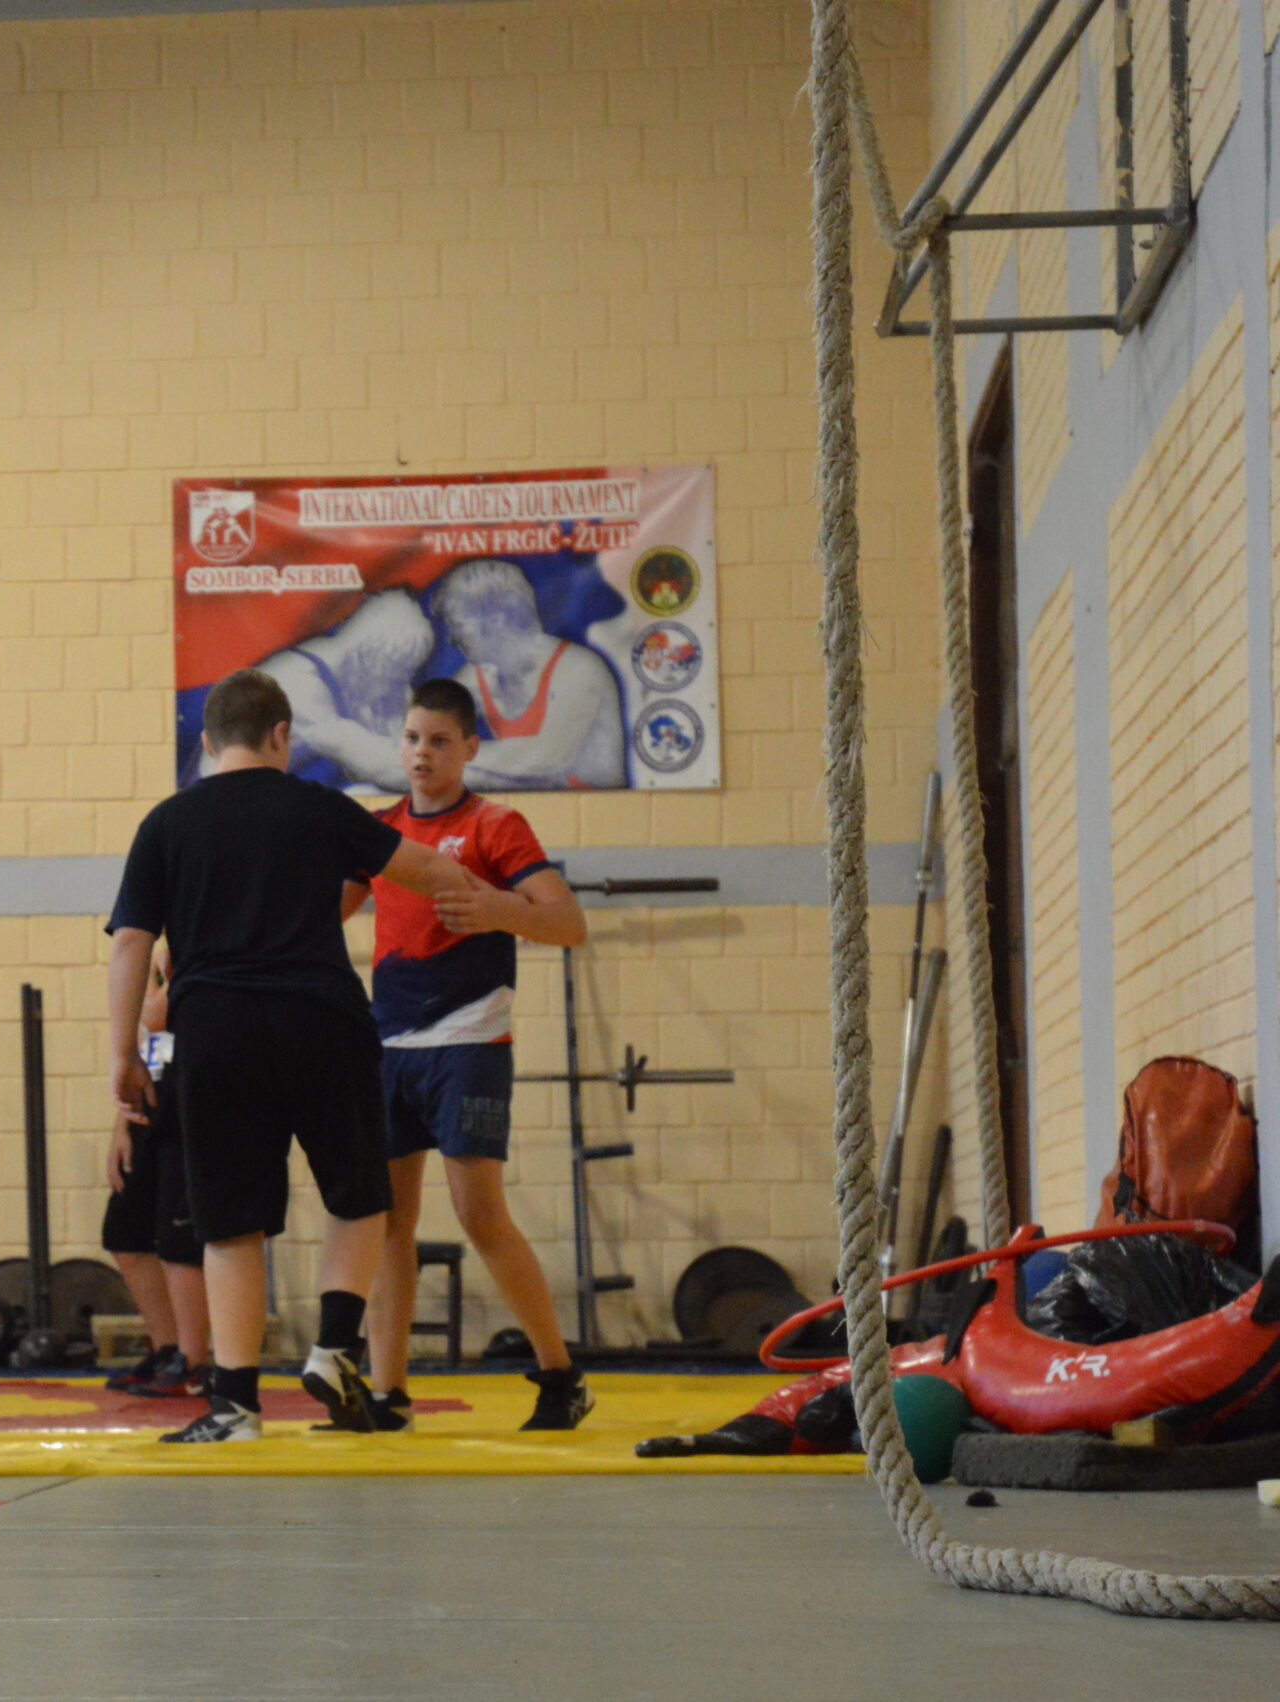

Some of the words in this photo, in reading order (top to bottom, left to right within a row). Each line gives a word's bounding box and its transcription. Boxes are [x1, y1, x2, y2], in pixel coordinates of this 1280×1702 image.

[303, 491, 442, 522] INTERNATIONAL
[446, 488, 513, 519] CADETS
[516, 482, 637, 516] TOURNAMENT
[190, 570, 281, 589] SOMBOR,
[284, 569, 357, 587] SERBIA
